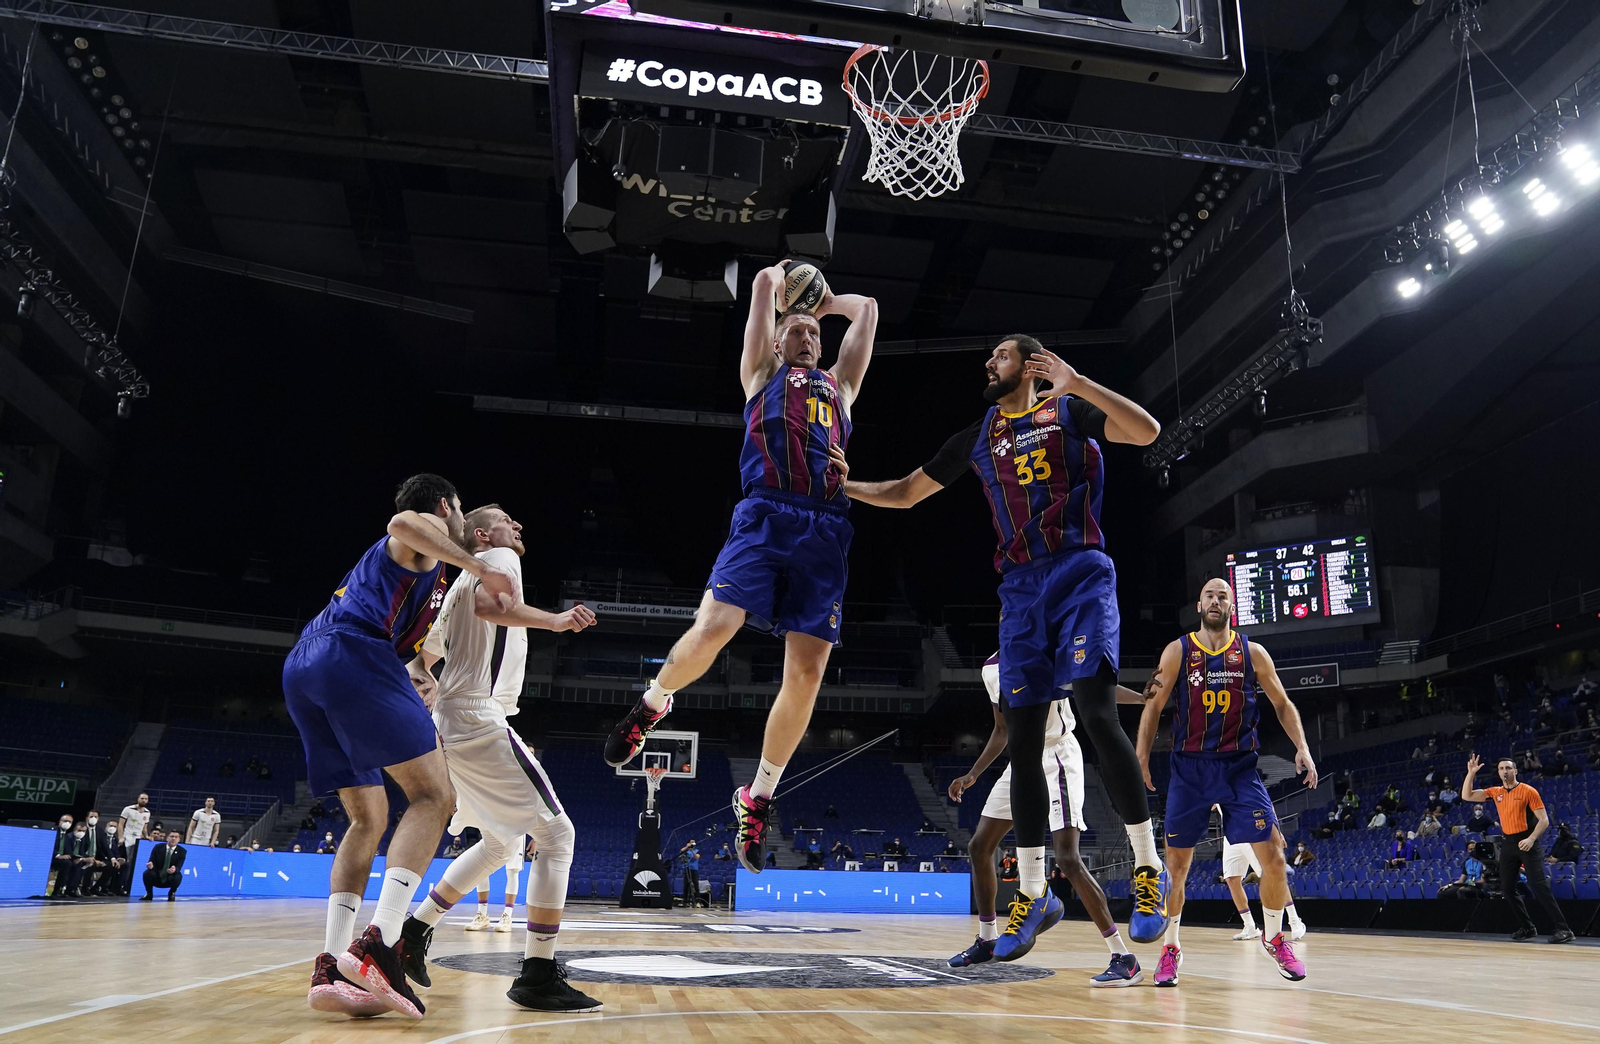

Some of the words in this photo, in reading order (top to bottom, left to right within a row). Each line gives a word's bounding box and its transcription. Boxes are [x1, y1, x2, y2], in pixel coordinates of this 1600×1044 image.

[606, 57, 823, 106] #CopaACB
[806, 396, 833, 428] 10
[1013, 447, 1052, 486] 33
[1275, 547, 1288, 560] 37
[1302, 544, 1315, 556] 42
[597, 603, 647, 614] Comunidad
[650, 606, 661, 614] de
[663, 608, 694, 616] Madrid
[1300, 674, 1324, 686] acb
[1202, 690, 1231, 714] 99
[0, 775, 70, 793] SALIDA
[15, 790, 49, 802] EXIT
